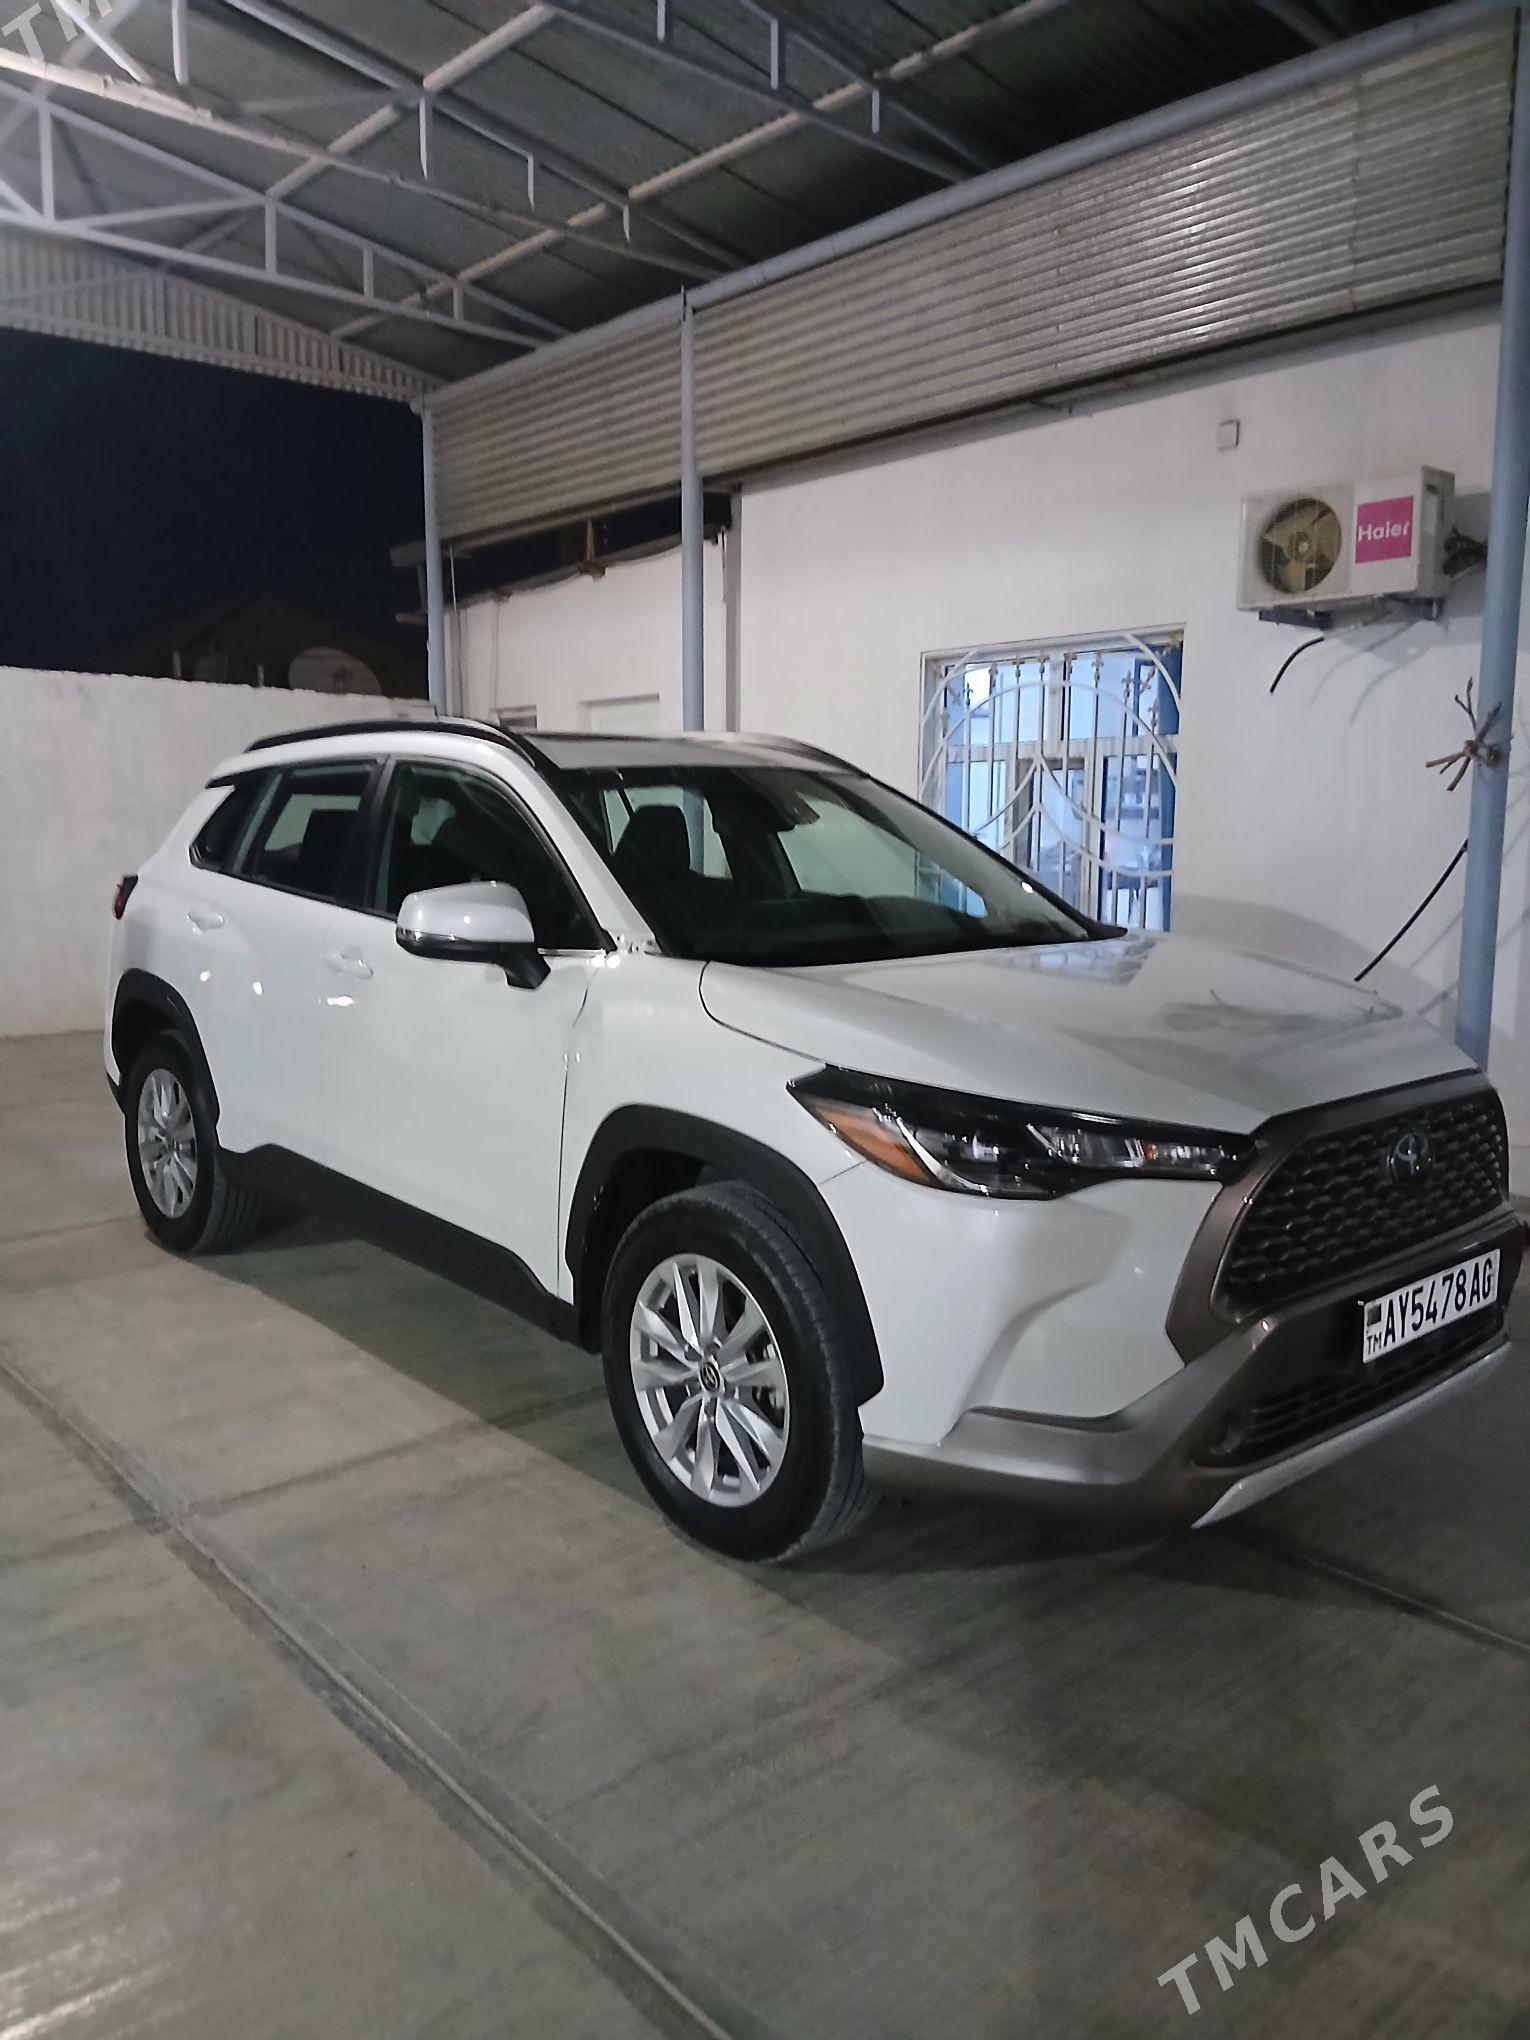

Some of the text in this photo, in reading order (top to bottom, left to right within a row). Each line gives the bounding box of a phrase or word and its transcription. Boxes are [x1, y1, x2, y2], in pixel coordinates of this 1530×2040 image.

[1358, 520, 1410, 542] Haier
[1367, 1257, 1493, 1355] TM AY5478AG
